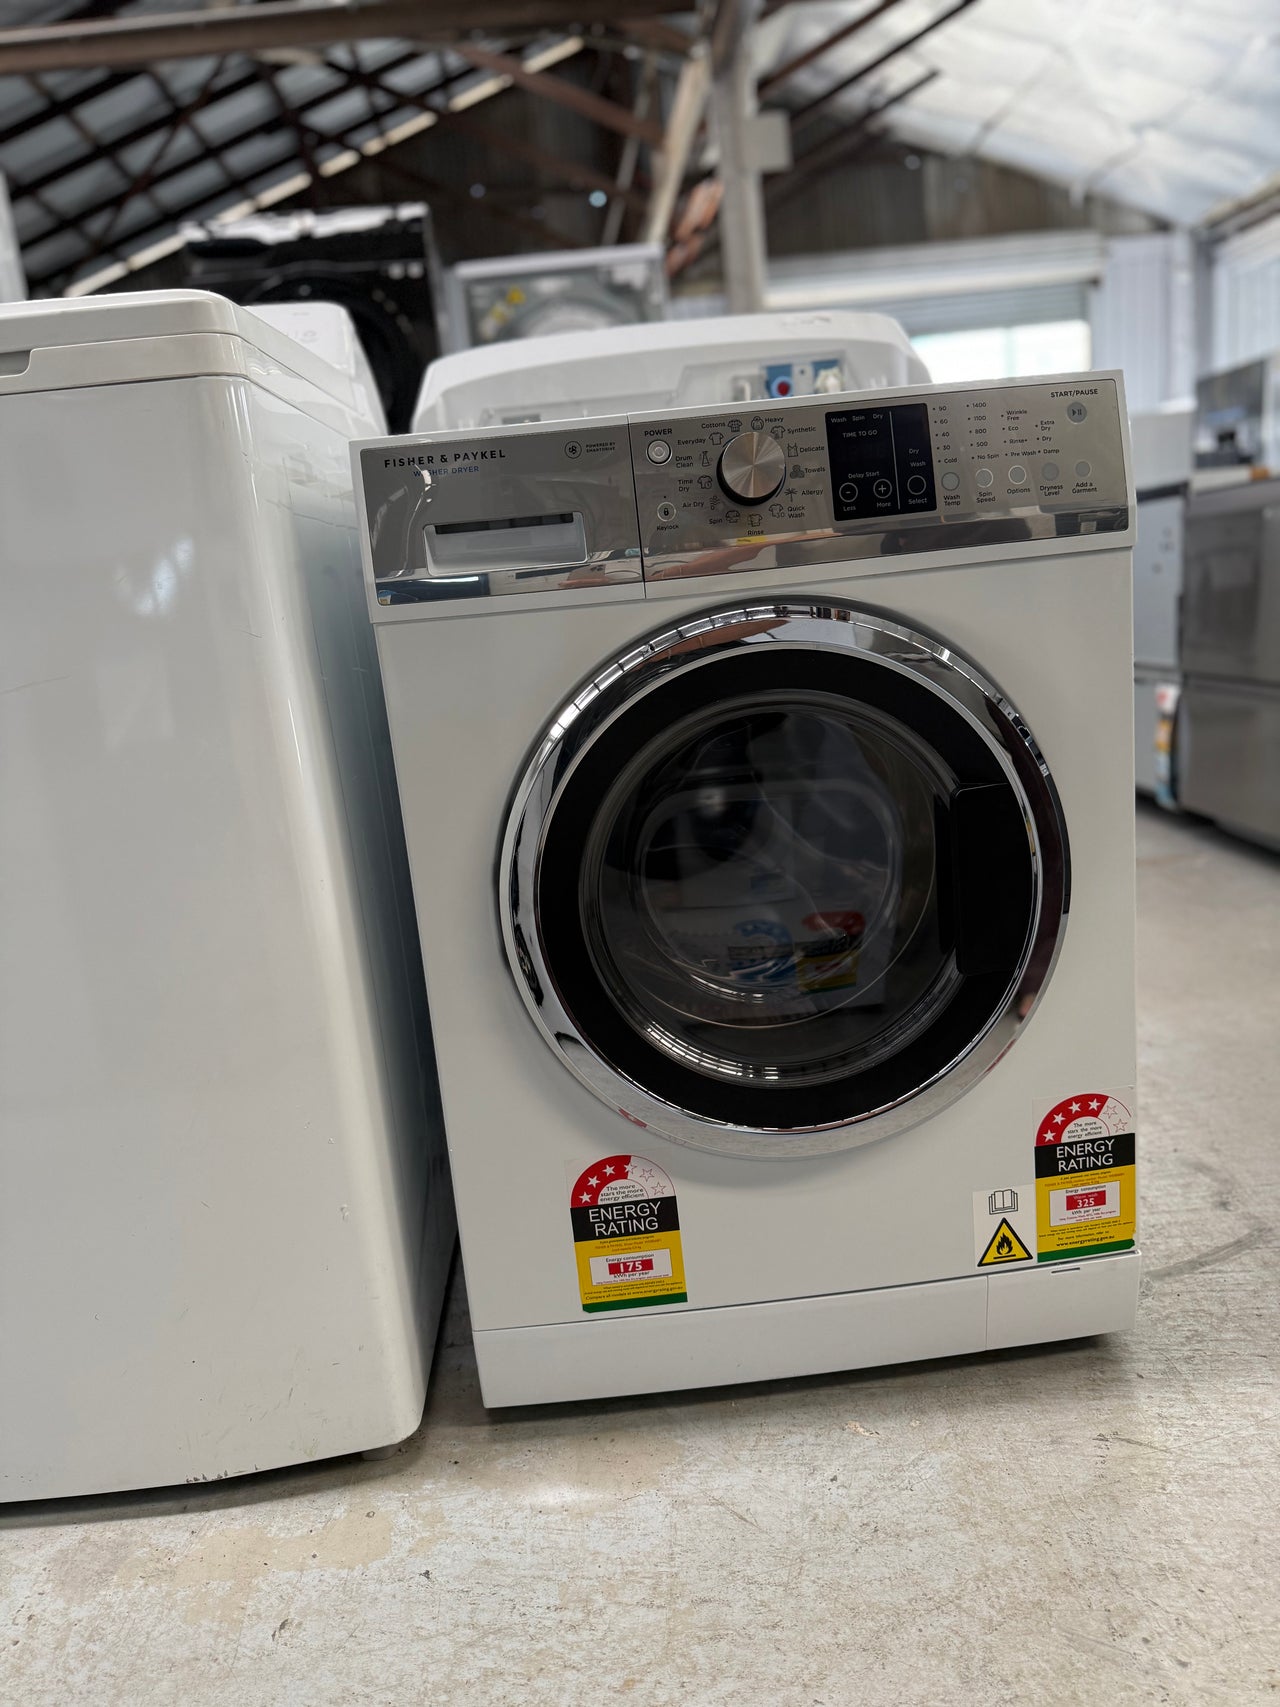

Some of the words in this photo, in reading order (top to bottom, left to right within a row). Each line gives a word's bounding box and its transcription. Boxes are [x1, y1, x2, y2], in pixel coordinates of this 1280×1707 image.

[1050, 388, 1098, 398] START/PAUSE
[644, 428, 672, 437] POWER
[787, 426, 816, 435] Synthetic
[800, 445, 825, 453] Delicate
[384, 455, 434, 468] FISHER
[440, 454, 448, 463] &
[454, 449, 506, 462] PAYKEL
[413, 468, 449, 477] WSHER
[451, 465, 479, 474] DRYER
[805, 466, 826, 474] Towels
[1006, 487, 1031, 495] Options
[976, 496, 996, 504] Speed
[1056, 1138, 1115, 1159] ENERGY
[1058, 1153, 1113, 1173] RATING
[1077, 1197, 1095, 1208] 325
[588, 1200, 661, 1223] ENERGY
[594, 1216, 659, 1237] RATING
[620, 1261, 643, 1273] 175
